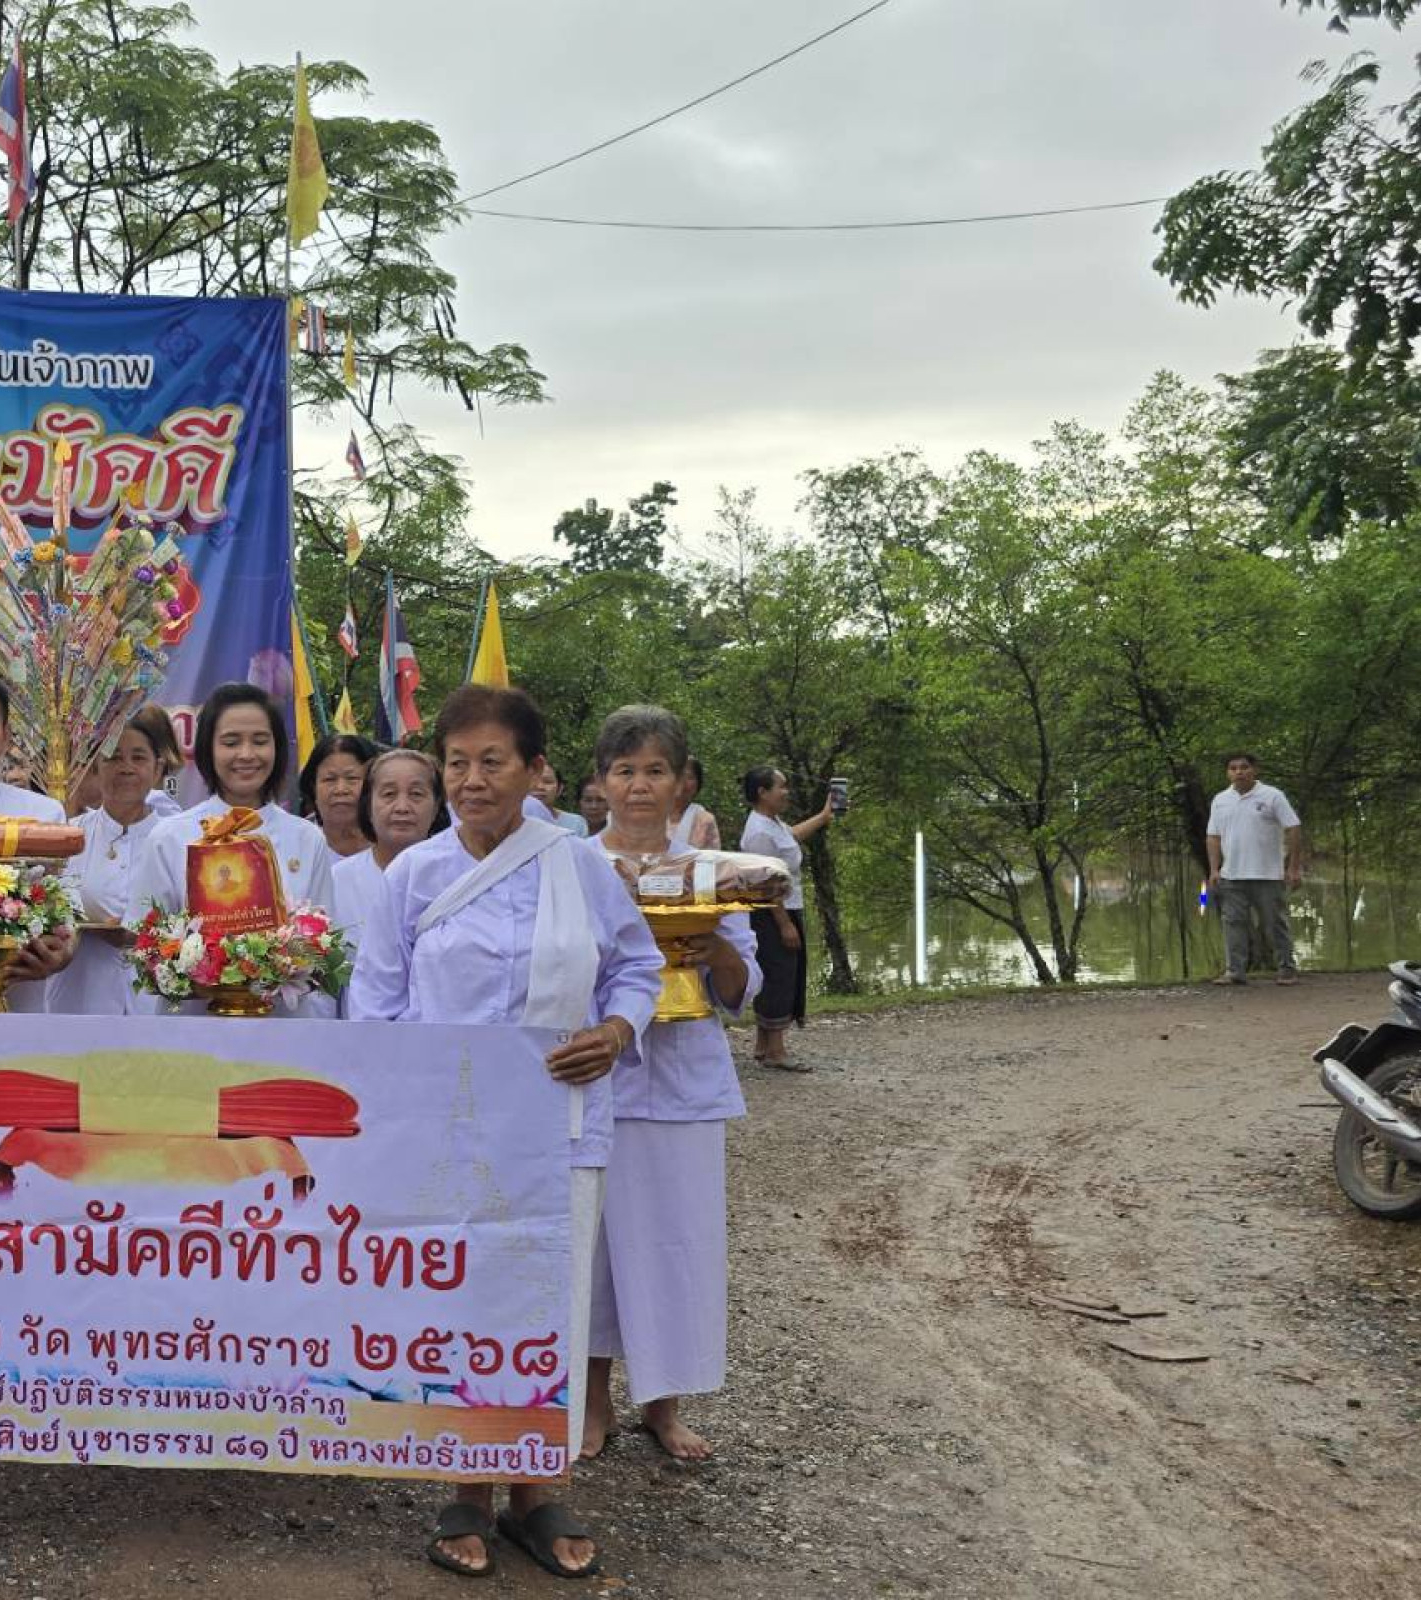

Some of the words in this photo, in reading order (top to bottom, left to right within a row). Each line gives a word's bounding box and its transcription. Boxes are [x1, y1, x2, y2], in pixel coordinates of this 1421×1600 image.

[19, 1313, 70, 1357] วัด
[86, 1317, 330, 1376] พุทธศักราช
[350, 1323, 559, 1377] ๒๕๖๘
[277, 1425, 299, 1460] ปี
